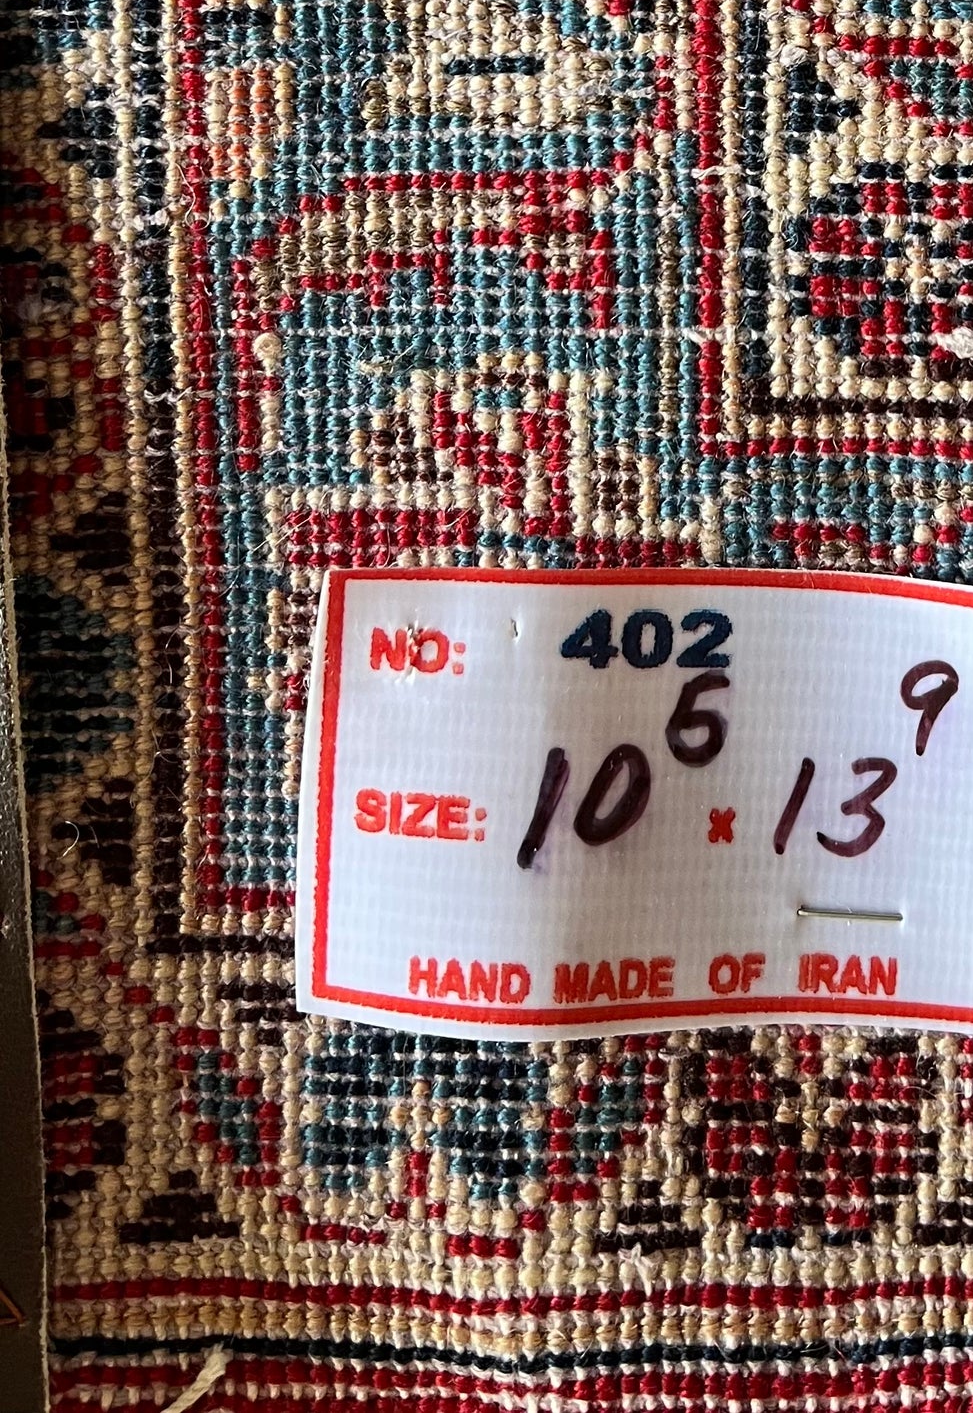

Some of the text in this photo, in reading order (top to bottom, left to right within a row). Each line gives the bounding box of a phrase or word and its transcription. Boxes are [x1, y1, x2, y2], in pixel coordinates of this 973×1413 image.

[369, 608, 733, 674] NO: 402
[353, 788, 487, 841] SIZE:
[408, 952, 898, 1004] HAND MADE OF IRAN
